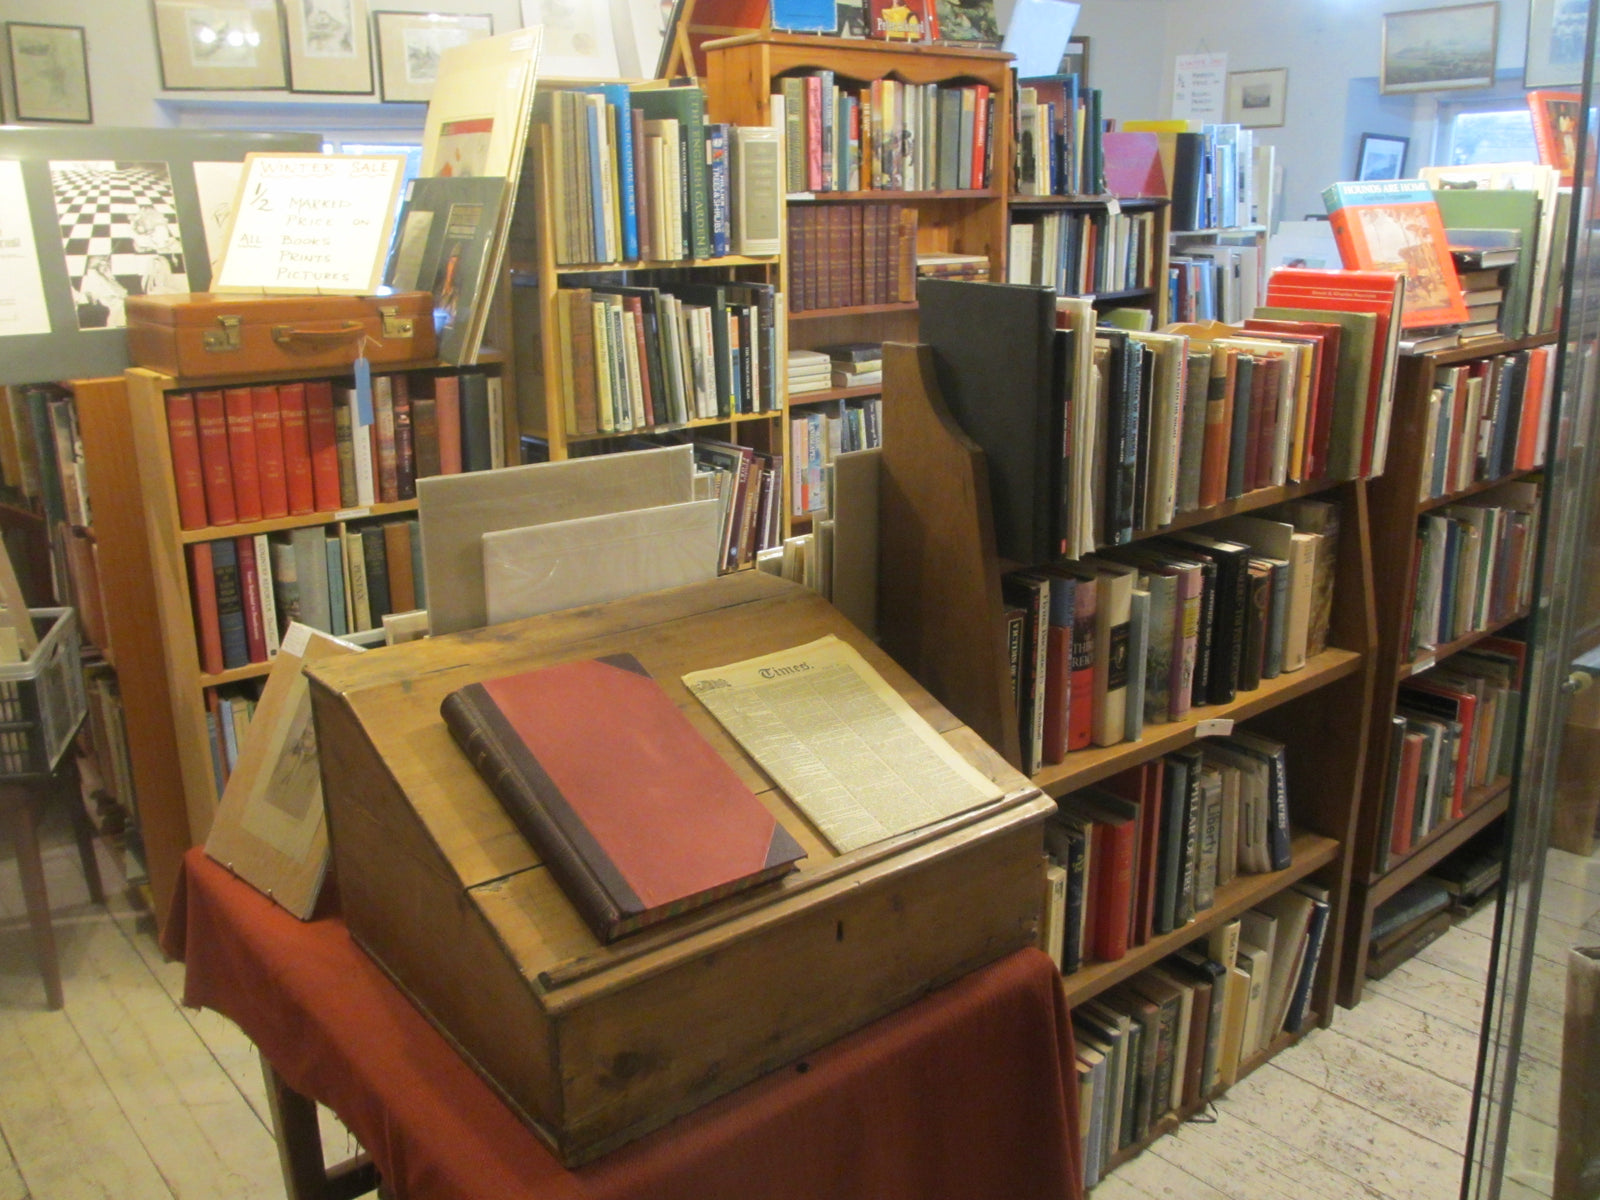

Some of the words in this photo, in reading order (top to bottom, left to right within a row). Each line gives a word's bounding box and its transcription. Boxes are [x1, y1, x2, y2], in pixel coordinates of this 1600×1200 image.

[691, 101, 701, 124] THE
[261, 161, 334, 173] WINTER
[352, 162, 391, 173] SALE
[626, 144, 634, 183] CENTRAL
[692, 130, 703, 188] ENGLISH
[288, 196, 351, 210] MARKED
[1343, 184, 1382, 195] HOUNDS
[1383, 183, 1400, 193] ARE
[1400, 182, 1427, 193] HOME
[286, 215, 333, 227] PRICE
[353, 218, 369, 226] ON
[694, 190, 706, 246] GARDEN
[239, 232, 262, 244] ALL
[281, 234, 331, 246] BOOKS
[279, 250, 332, 263] PRINTS
[275, 266, 350, 282] PICTURES
[1207, 589, 1215, 625] GERMANY
[1011, 622, 1020, 664] VICTIMS
[1187, 781, 1200, 835] PILLAR
[1276, 761, 1286, 829] ANTIQUES
[1203, 803, 1220, 855] Liberty
[1186, 838, 1195, 857] OF
[1183, 861, 1194, 896] FIRE
